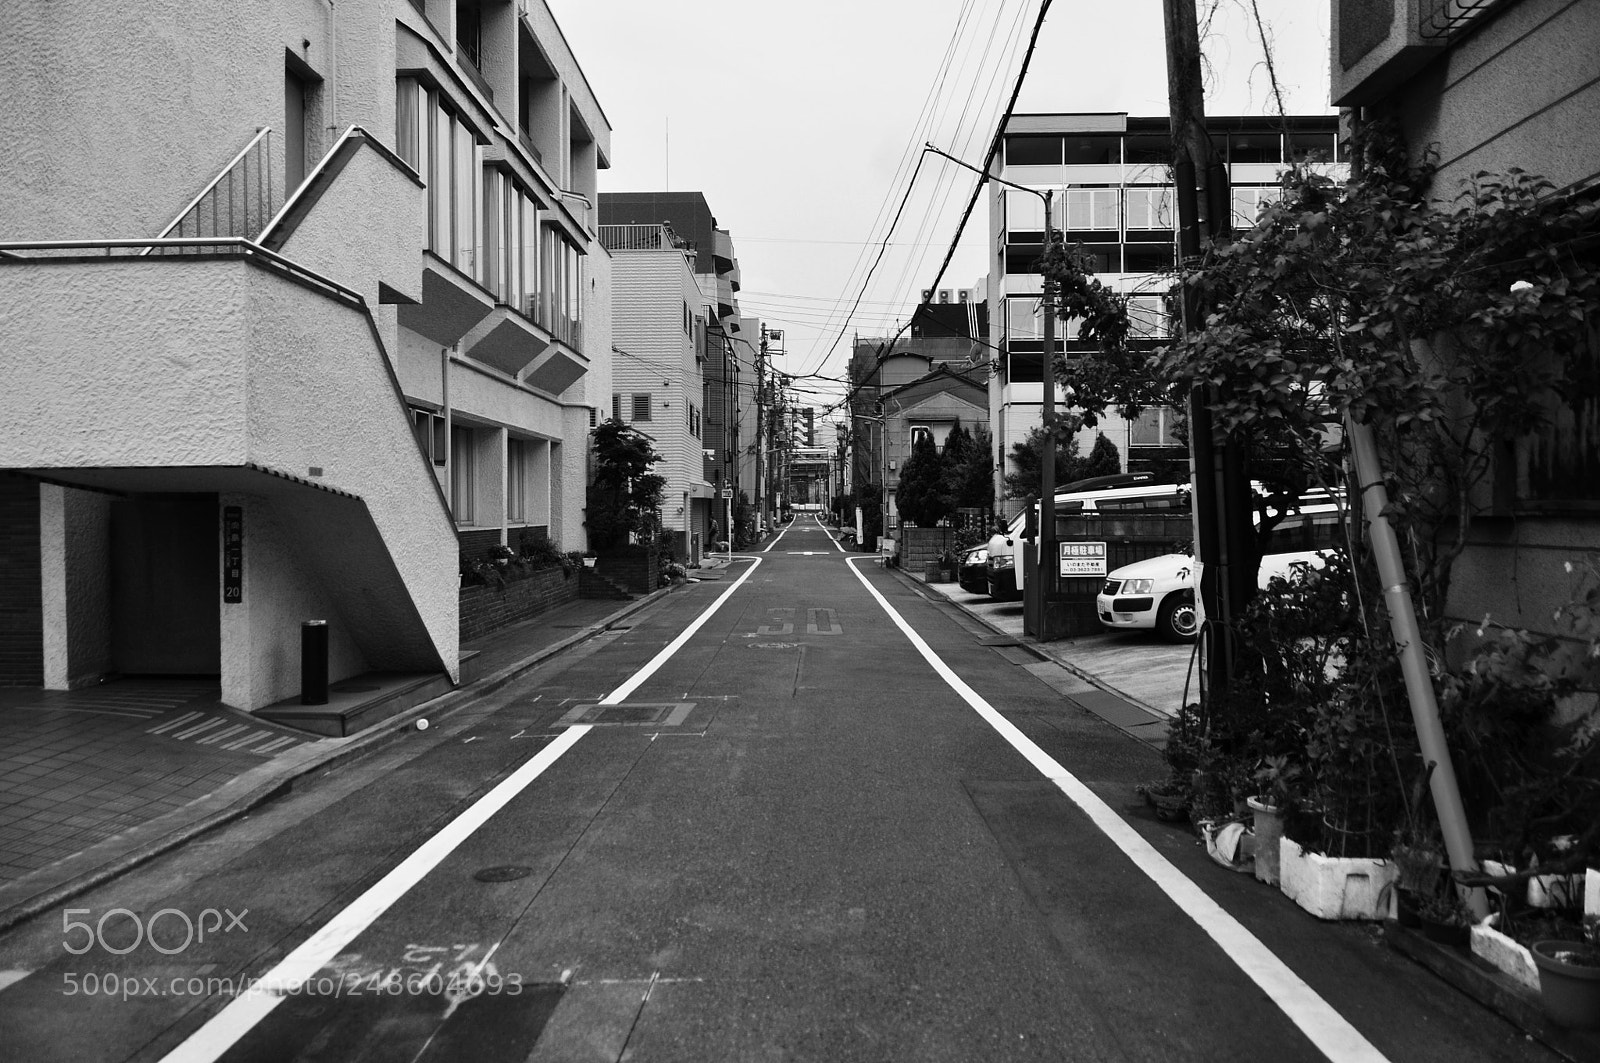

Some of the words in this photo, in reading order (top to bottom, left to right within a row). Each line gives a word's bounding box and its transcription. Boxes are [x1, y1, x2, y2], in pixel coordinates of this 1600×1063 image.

[1063, 545, 1103, 555] 月極駐車場
[226, 587, 240, 598] 20
[756, 607, 844, 635] 30
